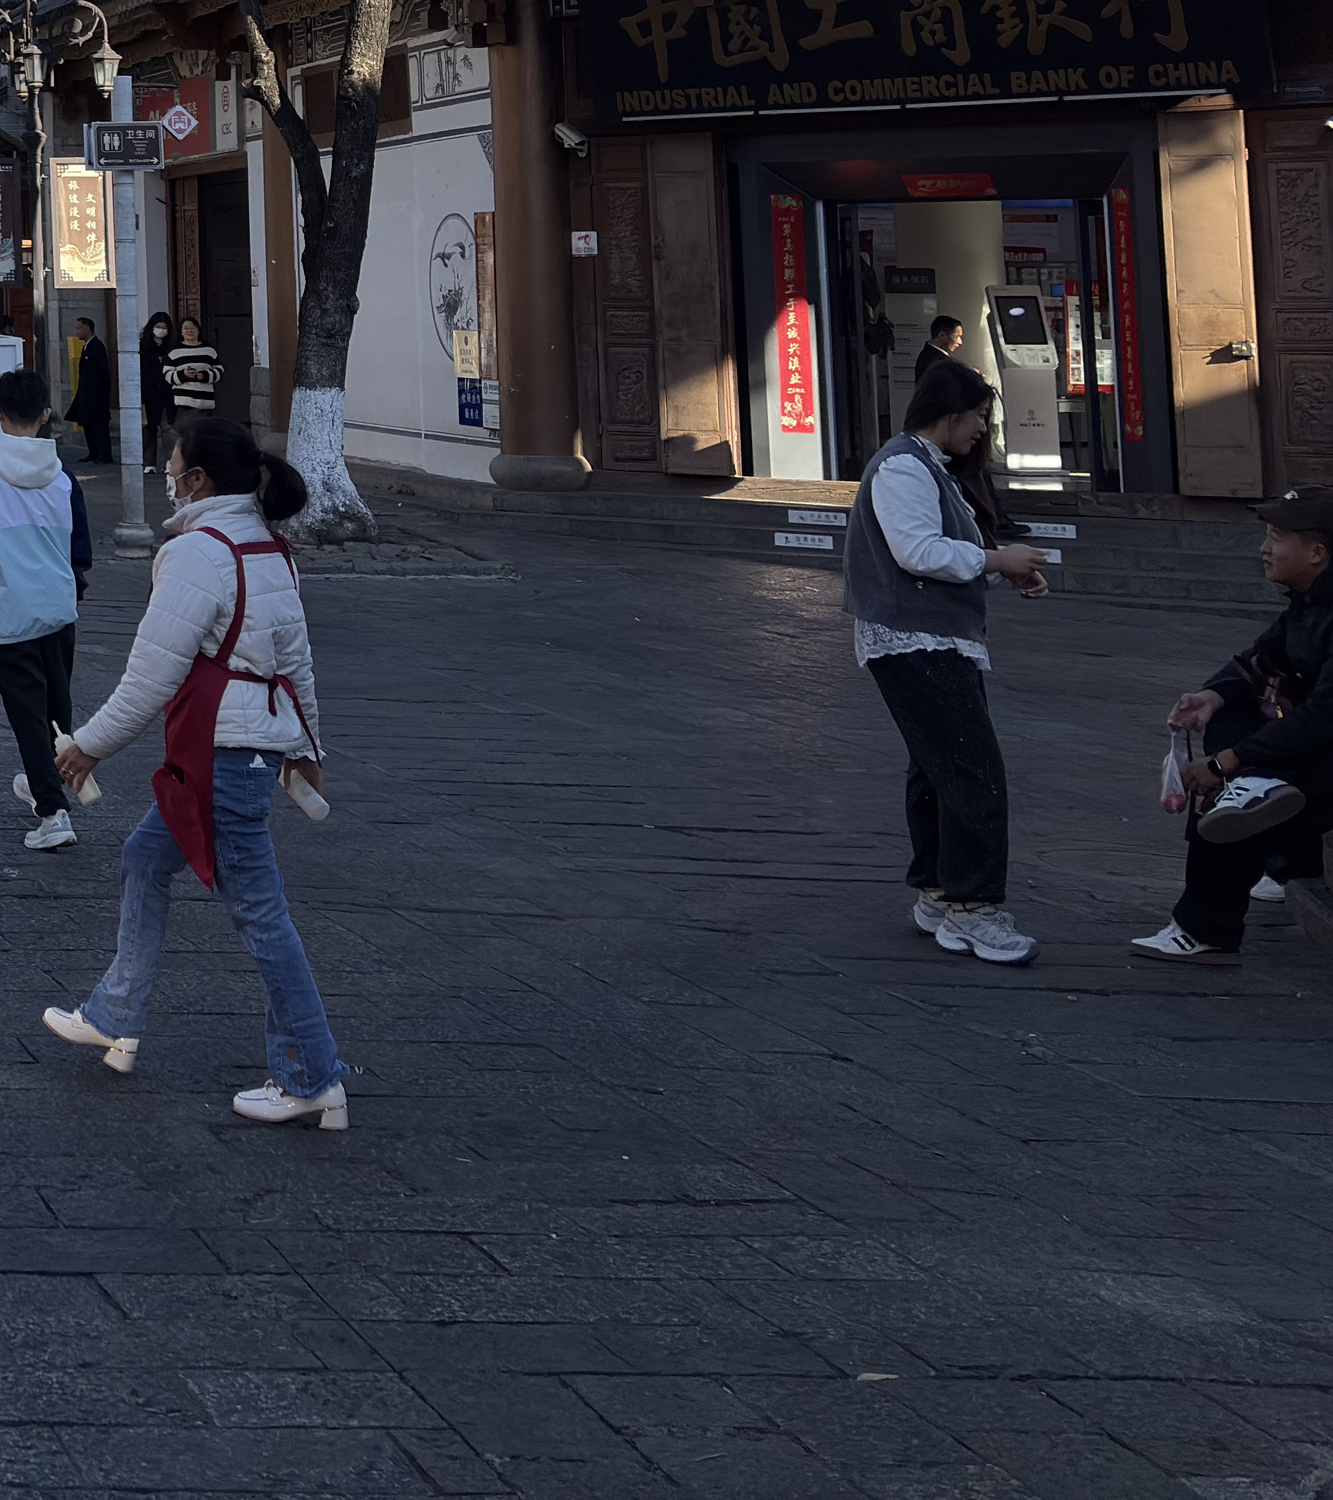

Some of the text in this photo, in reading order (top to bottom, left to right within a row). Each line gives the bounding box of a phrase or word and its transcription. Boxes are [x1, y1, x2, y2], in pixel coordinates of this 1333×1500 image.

[616, 60, 1240, 113] INDUSTRIAL AND COMMERCIAL BANK OF CHINA
[125, 129, 155, 139] 卫生间
[67, 180, 81, 231] 旅途漫漫
